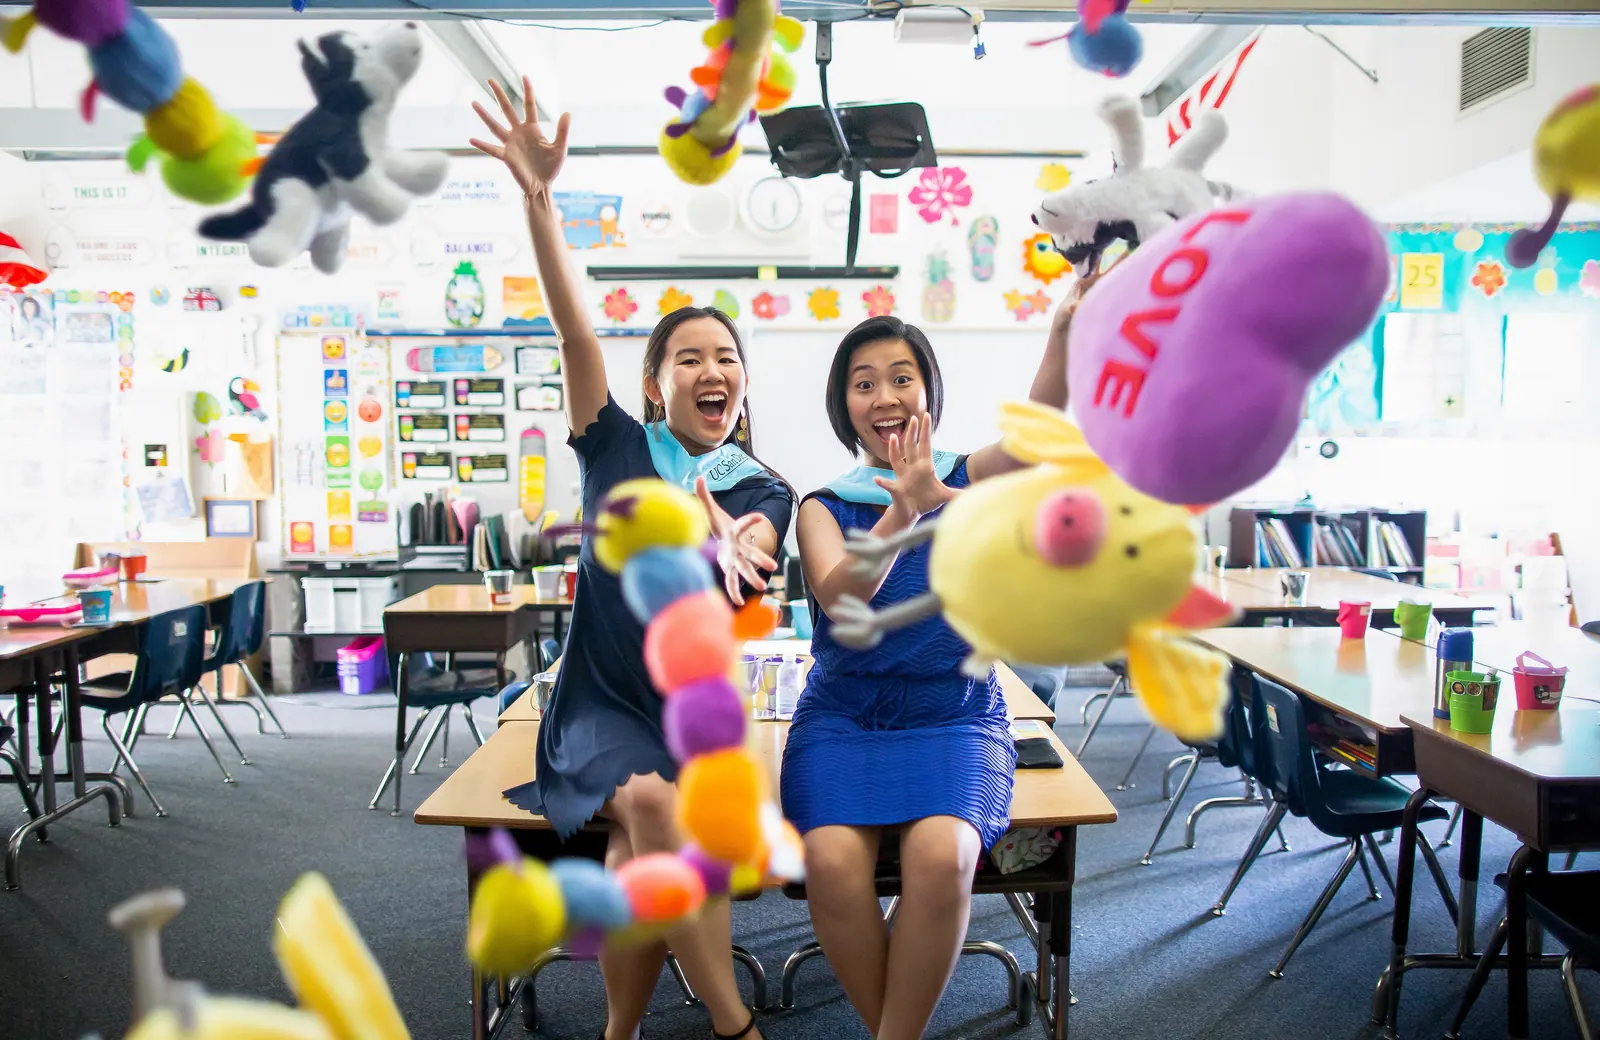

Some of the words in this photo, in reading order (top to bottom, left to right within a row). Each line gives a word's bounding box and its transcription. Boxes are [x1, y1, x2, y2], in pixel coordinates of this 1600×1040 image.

[73, 186, 99, 198] THIS
[102, 186, 114, 198] IS
[116, 186, 127, 198] IT
[444, 243, 493, 253] BALANCE
[1408, 265, 1437, 288] 25
[1092, 209, 1252, 419] LOVE
